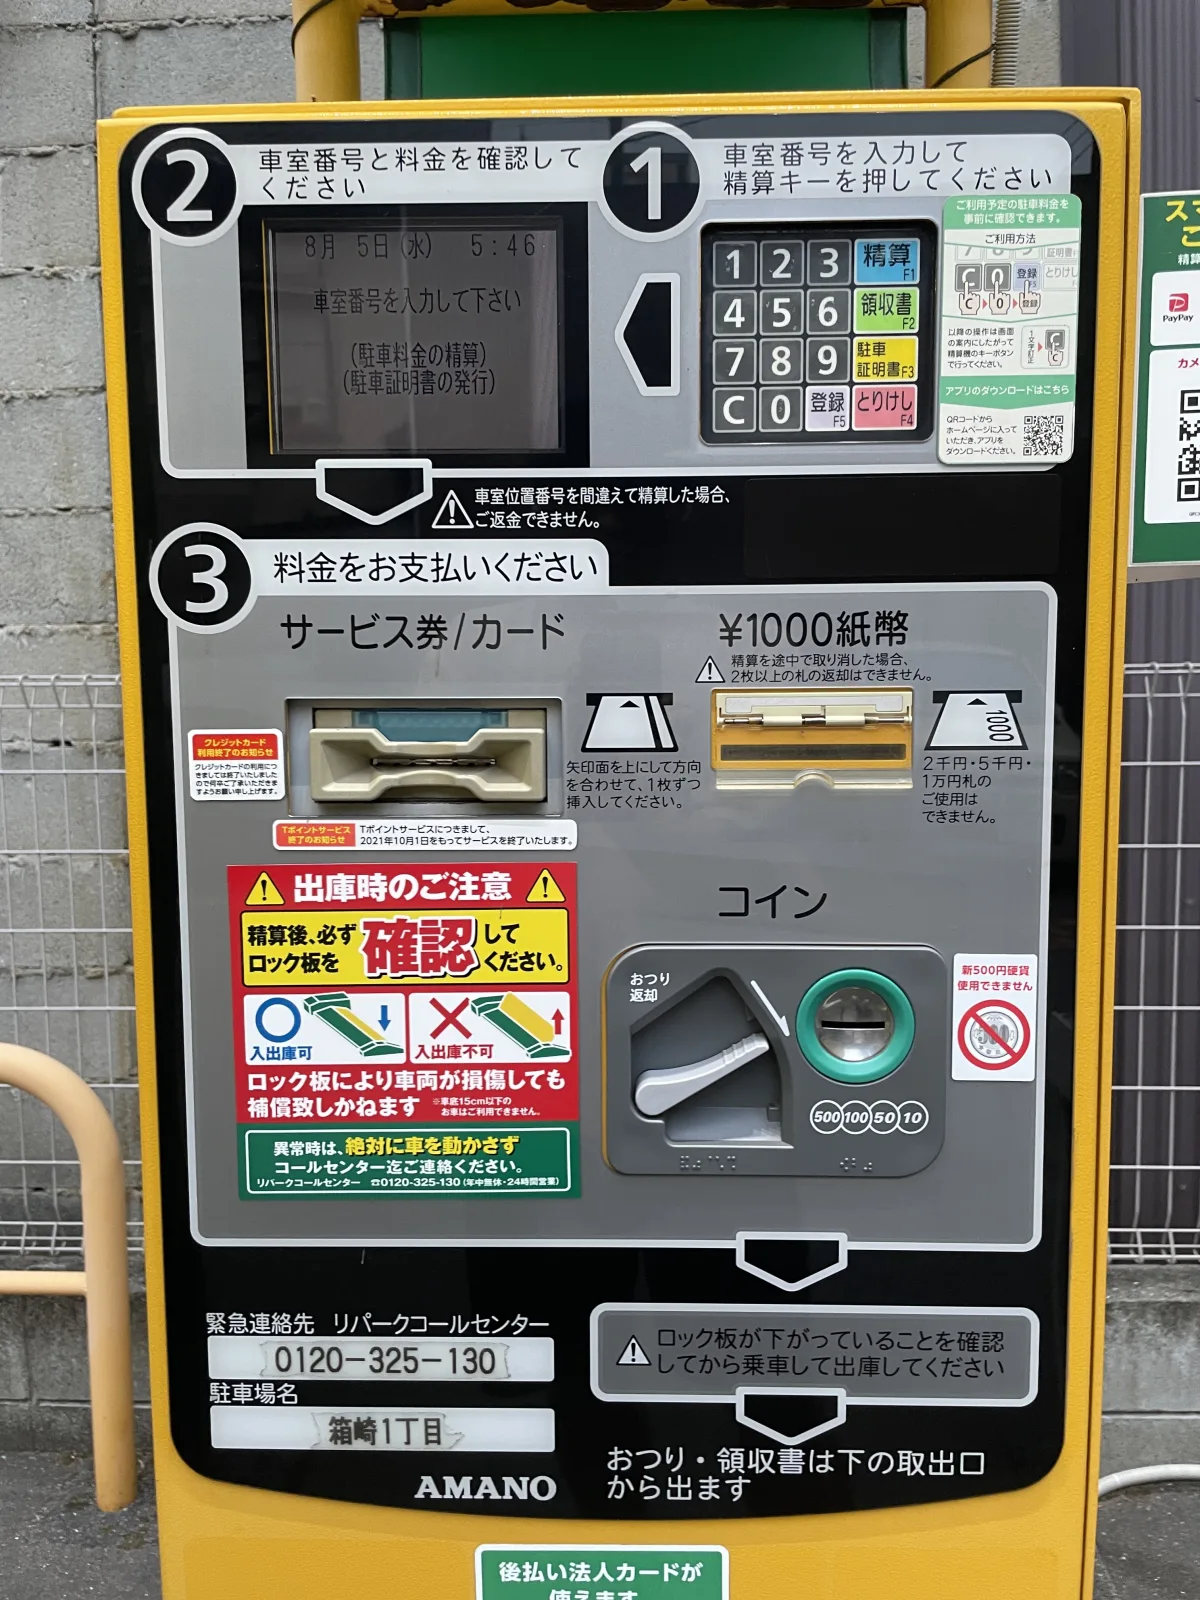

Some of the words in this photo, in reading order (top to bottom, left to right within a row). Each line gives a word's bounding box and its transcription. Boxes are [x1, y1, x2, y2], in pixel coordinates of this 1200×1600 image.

[259, 146, 583, 173] 車室番号と料金を確認して
[723, 140, 968, 168] 車室番号を入力して
[165, 149, 214, 223] 2
[261, 176, 367, 199] ください
[629, 146, 662, 220] 1
[723, 166, 1053, 196] 精算キーを押してください
[956, 199, 1069, 211] ご利用予定の駐車料金を
[963, 212, 1061, 225] 事前に確認できます。
[985, 233, 1036, 245] ご利用方法
[726, 249, 741, 279] 1
[771, 248, 792, 279] 2
[818, 247, 839, 278] 3
[863, 243, 911, 268] 精算
[903, 268, 915, 281] F1
[1016, 268, 1038, 279] 登録
[313, 287, 521, 315] 車室番号を入力して下さい
[861, 293, 912, 317] 領収書
[965, 299, 973, 309] C
[1022, 299, 1038, 308] 登録
[723, 298, 745, 328] 4
[772, 297, 791, 327] 5
[818, 296, 838, 327] 6
[1162, 314, 1194, 323] PayPay
[902, 317, 915, 330] F2
[948, 327, 1015, 337] 以降の操作は画面
[857, 342, 886, 358] 駐車
[948, 338, 1014, 347] の案内にしたがって
[725, 347, 745, 377] 7
[771, 346, 791, 376] 8
[817, 345, 838, 375] 9
[947, 349, 1014, 358] 精算機のキーボタン
[857, 362, 900, 378] 証明書
[901, 365, 915, 379] F3
[947, 360, 1003, 369] で行ってください。
[945, 385, 1070, 396] アプリのダウンロードはこちら
[722, 395, 745, 424] C
[770, 394, 791, 424] 0
[811, 392, 845, 412] 登録
[857, 391, 914, 412] とりけし
[833, 416, 846, 428] F5
[900, 412, 914, 426] F4
[946, 415, 993, 423] QRコードから
[946, 425, 1018, 434] ホームページに入って
[946, 437, 1004, 445] いただき、アプリを
[946, 447, 1016, 456] ダウンロードください。
[474, 486, 731, 505] 車室位置番号を間違えて精算した場合、
[474, 510, 601, 529] ご返金できません。
[273, 551, 598, 584] 料金をお支払いください
[184, 544, 229, 613] 3
[280, 612, 566, 651] サービス券/カード
[730, 653, 909, 668] 精算を途中で取り消した場合、
[730, 668, 932, 683] 2枚以上の札の返却はできません。
[986, 710, 1014, 741] 1000
[197, 748, 273, 757] 利用終了のお知らせ
[566, 760, 701, 774] 矢印面を上にして方向
[566, 777, 701, 792] を合わせて、1枚ずつ
[922, 774, 992, 788] 1万円札の
[566, 795, 683, 809] 挿入してください。
[922, 792, 978, 806] ご使用は
[922, 810, 996, 824] できません。
[282, 826, 351, 834] Tポイントサービス
[359, 824, 490, 834] Tポイントサービスにつきまして、
[287, 835, 346, 845] 終了のお知らせ
[360, 835, 573, 846] 2021年10月1日をもってサービスを終了いたします。
[293, 872, 513, 903] 出庫時のご注意
[718, 884, 828, 919] コイン
[247, 924, 356, 946] 精算後、必ず
[484, 924, 520, 943] して
[360, 916, 480, 979] 確認
[249, 953, 339, 974] ロック板を
[484, 952, 563, 972] ください。
[961, 965, 1030, 976] 新500円硬貨
[630, 972, 670, 986] おつり
[957, 981, 1033, 991] 使用できません
[629, 988, 658, 1003] 返却
[250, 1046, 312, 1061] 入出庫可
[415, 1044, 494, 1060] 入出庫不可
[248, 1070, 566, 1092] ロック板により車両が損傷しても
[247, 1097, 420, 1119] 補償致しかねます
[441, 1107, 540, 1117] お車はご利用できません。
[814, 1111, 840, 1123] 500
[844, 1111, 869, 1123] 100
[873, 1112, 896, 1124] 50
[903, 1112, 922, 1124] 10
[274, 1142, 345, 1157] 異常時は、
[275, 1159, 522, 1175] コールセンター迄ご連絡ください。
[206, 1312, 315, 1334] 緊急連絡先
[333, 1312, 550, 1334] リパークコールセンター
[657, 1328, 1004, 1353] ロック板が下がっていることを確認
[275, 1346, 496, 1374] 0120-325-130
[657, 1354, 1004, 1378] してから乗車して出庫してください
[209, 1382, 298, 1405] 駐車場名
[328, 1416, 442, 1446] 箱崎1丁目
[607, 1447, 985, 1476] おつり・領収書は下の取出口
[414, 1475, 557, 1501] AMANO
[607, 1476, 752, 1501] から出ます
[499, 1561, 704, 1583] 後払い法人カードが
